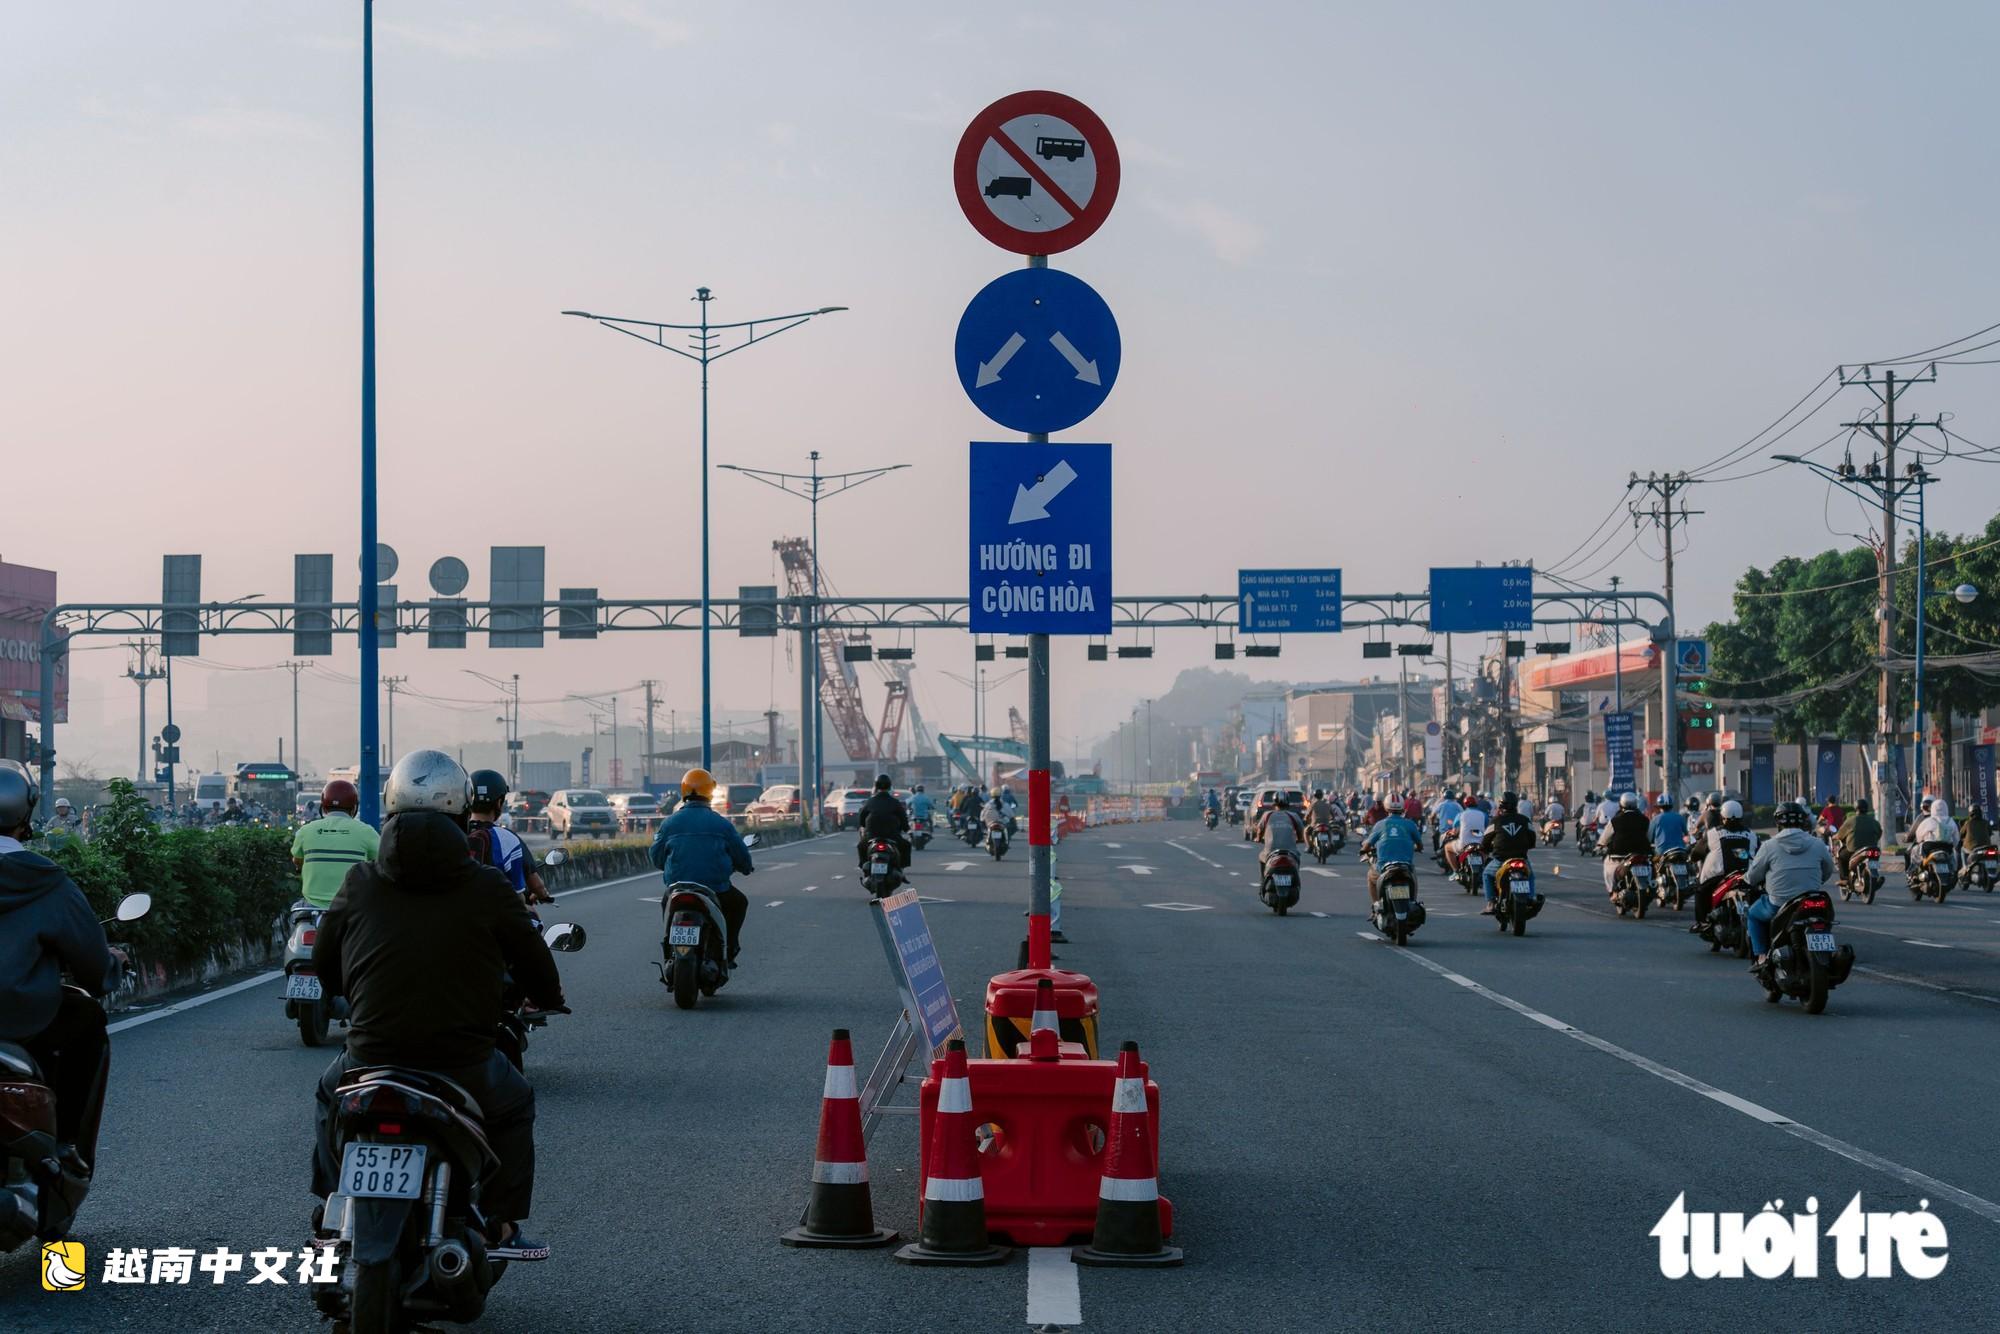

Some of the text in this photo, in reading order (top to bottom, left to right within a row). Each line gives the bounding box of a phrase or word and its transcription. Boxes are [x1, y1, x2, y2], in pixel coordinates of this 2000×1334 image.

[980, 538, 1092, 571] HƯỚNG ĐI
[1516, 578, 1530, 587] Km
[982, 580, 1095, 617] CỘNG HÒA
[1516, 600, 1530, 608] Km
[1516, 621, 1530, 629] Km
[356, 1147, 413, 1169] 55-P7
[352, 1171, 410, 1193] 8082
[521, 1248, 549, 1258] crocs
